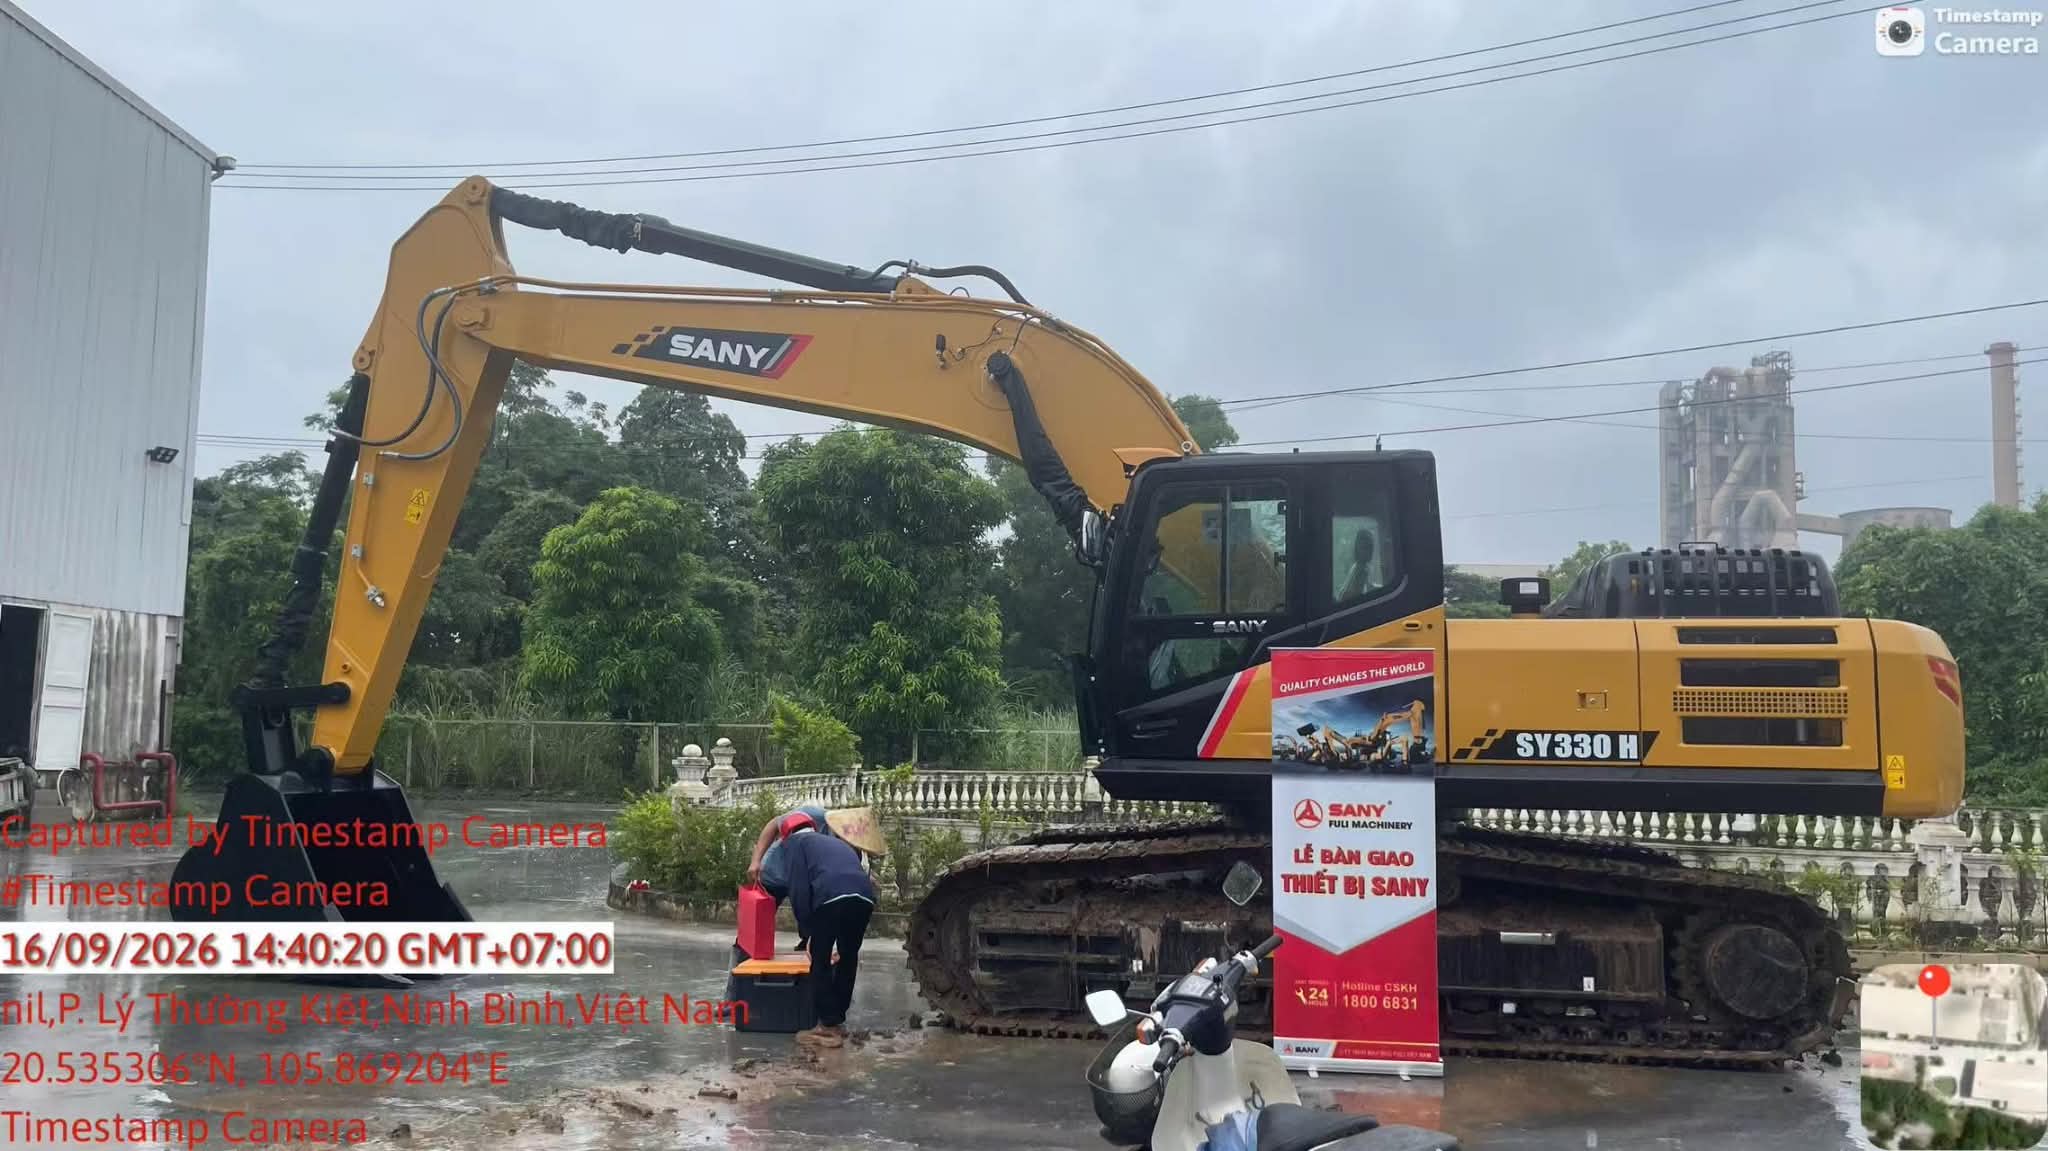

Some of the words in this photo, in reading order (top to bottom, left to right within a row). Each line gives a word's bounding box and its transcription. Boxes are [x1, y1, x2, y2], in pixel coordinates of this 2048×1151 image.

[668, 334, 770, 369] SANY
[1212, 619, 1268, 633] SANY
[1279, 677, 1321, 693] QUALITY
[1322, 670, 1368, 686] CHANGES
[1369, 666, 1388, 678] THE
[1389, 661, 1426, 675] WORLD
[1515, 732, 1611, 759] SY330
[1618, 734, 1639, 759] H
[1328, 803, 1387, 818] SANY
[1328, 820, 1350, 829] FULI
[1351, 820, 1413, 830] MACHINERY
[1294, 843, 1315, 864] LỄ
[1320, 846, 1361, 865] BÀN
[1367, 850, 1415, 867] GIAO
[1281, 868, 1339, 895] THIẾT
[1343, 874, 1366, 899] BỊ
[1371, 876, 1430, 898] SANY
[1308, 987, 1329, 1000] 24
[1342, 982, 1381, 992] Hotline
[1384, 983, 1418, 993] CSKH
[1343, 995, 1378, 1009] 1800
[1382, 996, 1418, 1010] 6831
